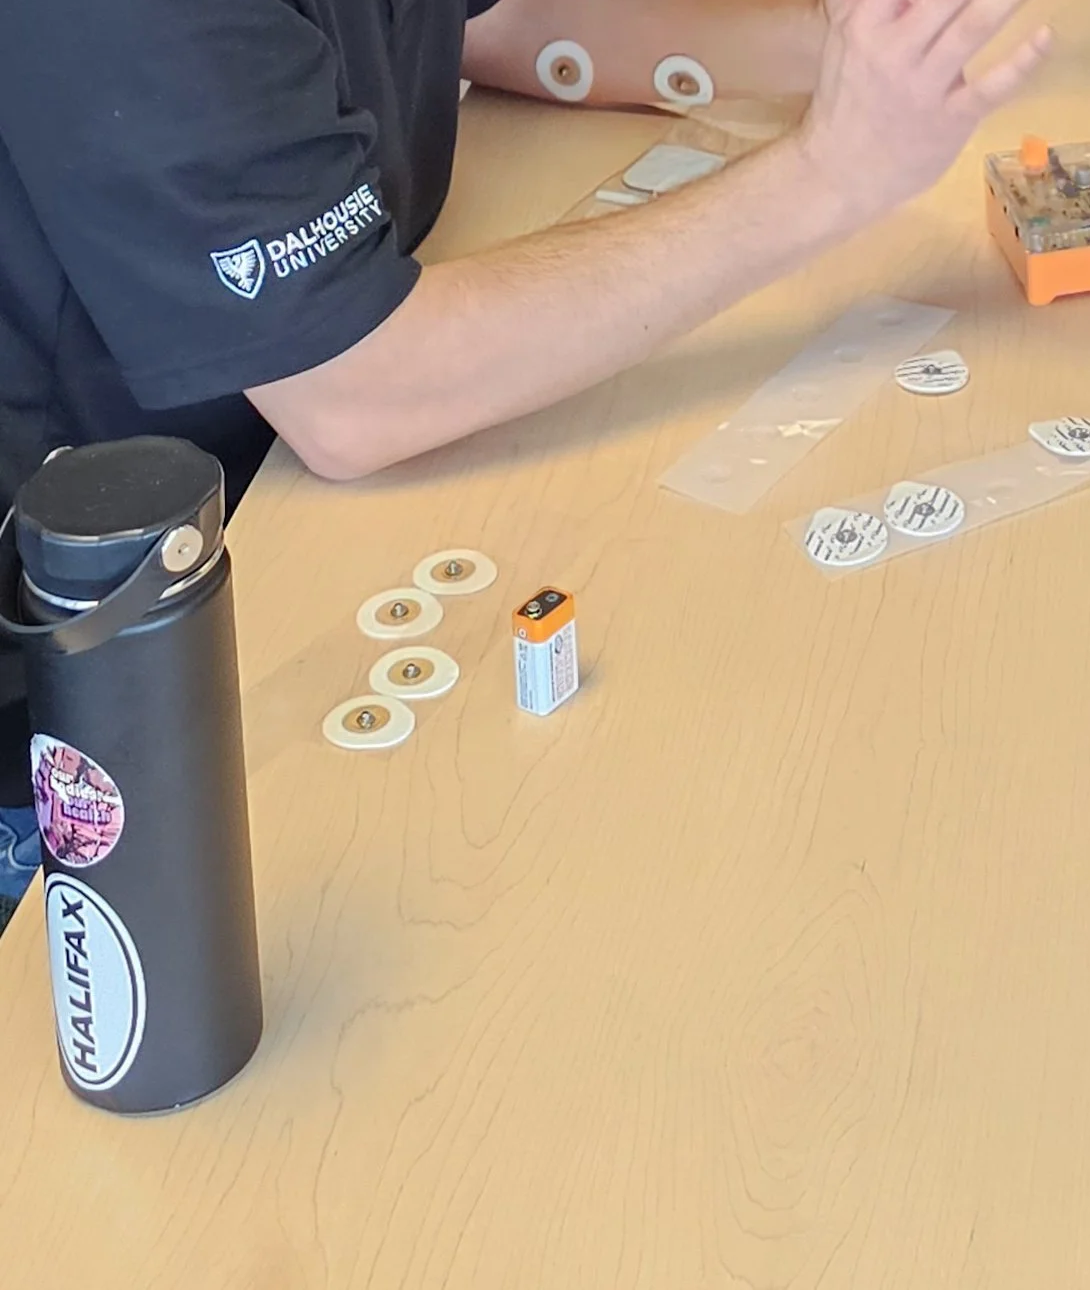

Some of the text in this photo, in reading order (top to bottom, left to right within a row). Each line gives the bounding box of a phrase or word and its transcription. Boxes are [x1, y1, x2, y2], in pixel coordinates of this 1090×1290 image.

[266, 183, 375, 261] DALHOUSIE
[273, 199, 383, 278] UNIVERSITY
[60, 890, 97, 1073] HALIFAX
